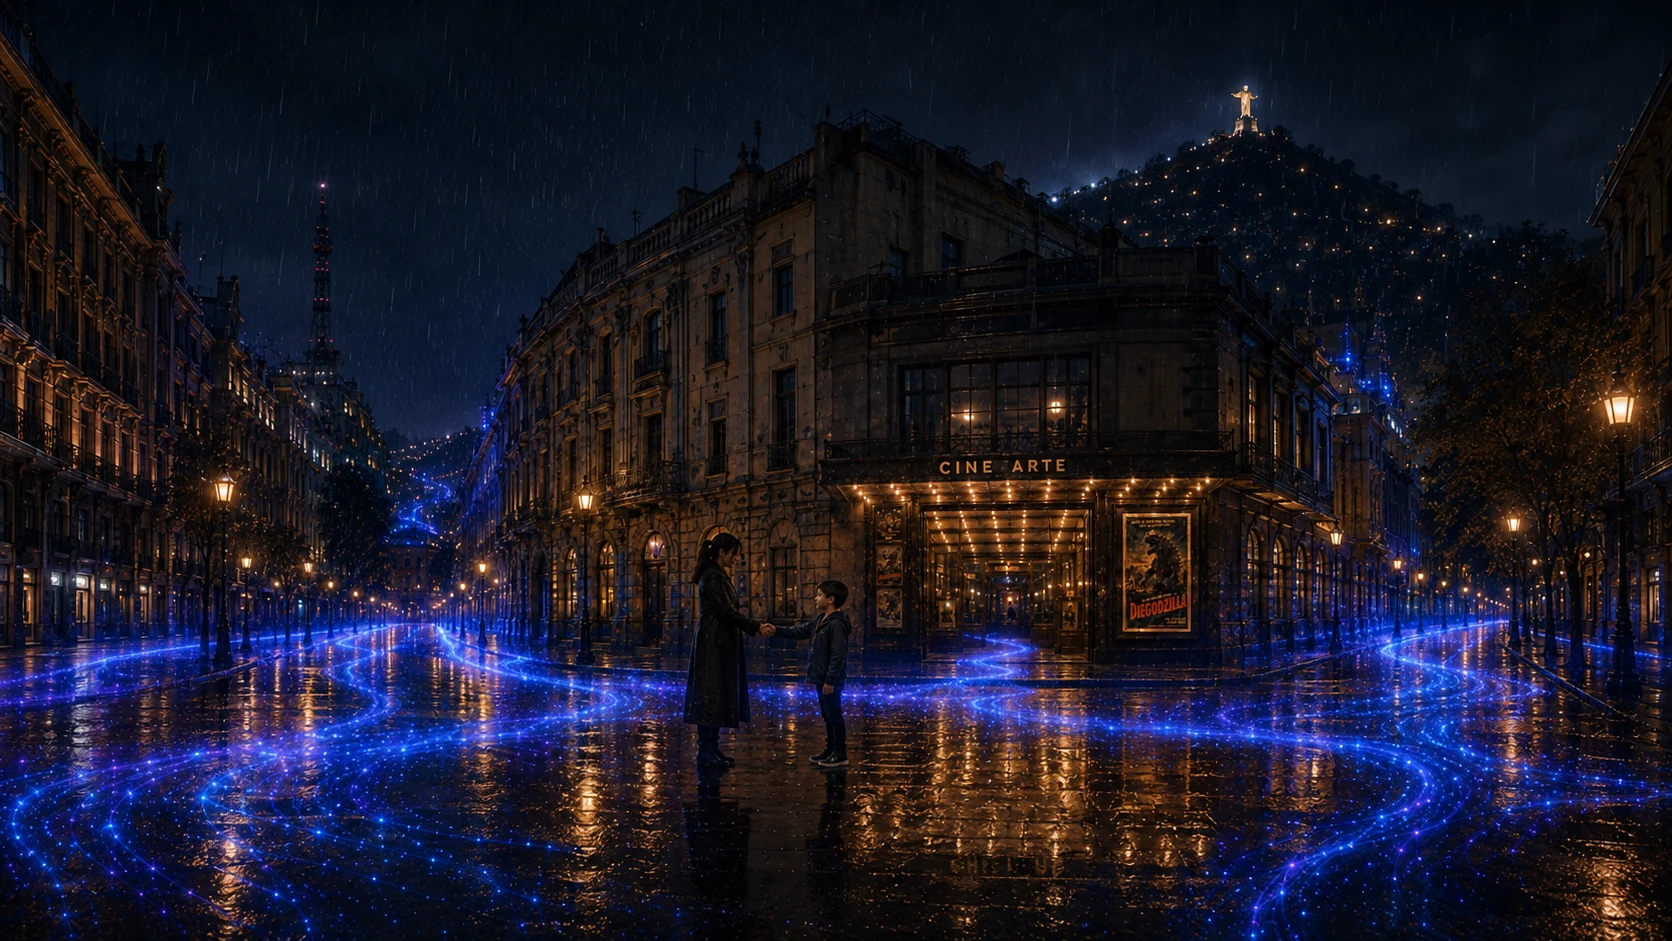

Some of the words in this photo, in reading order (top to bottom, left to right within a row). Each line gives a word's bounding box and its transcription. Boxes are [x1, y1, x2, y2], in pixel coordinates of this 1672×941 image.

[939, 460, 993, 475] CINE
[1011, 458, 1066, 473] ARTE
[1129, 593, 1187, 620] DIEGODZILLA
